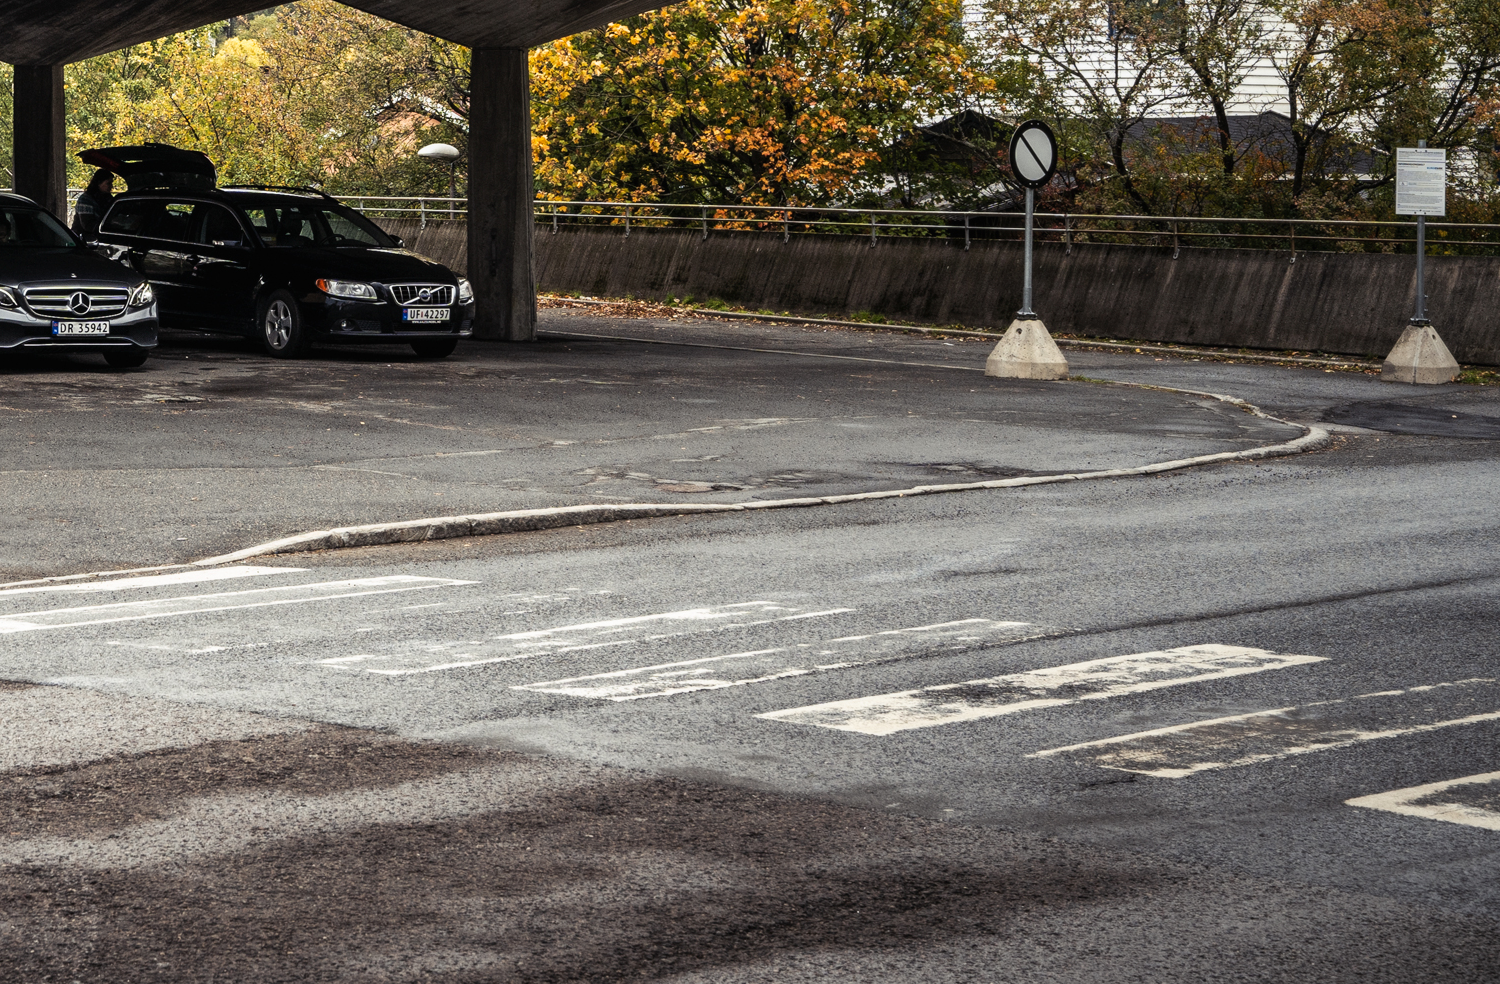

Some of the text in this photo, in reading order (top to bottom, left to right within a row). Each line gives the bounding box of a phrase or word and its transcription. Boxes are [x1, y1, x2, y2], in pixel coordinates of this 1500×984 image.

[410, 309, 449, 319] UF 42297
[60, 323, 108, 333] DR 35942
